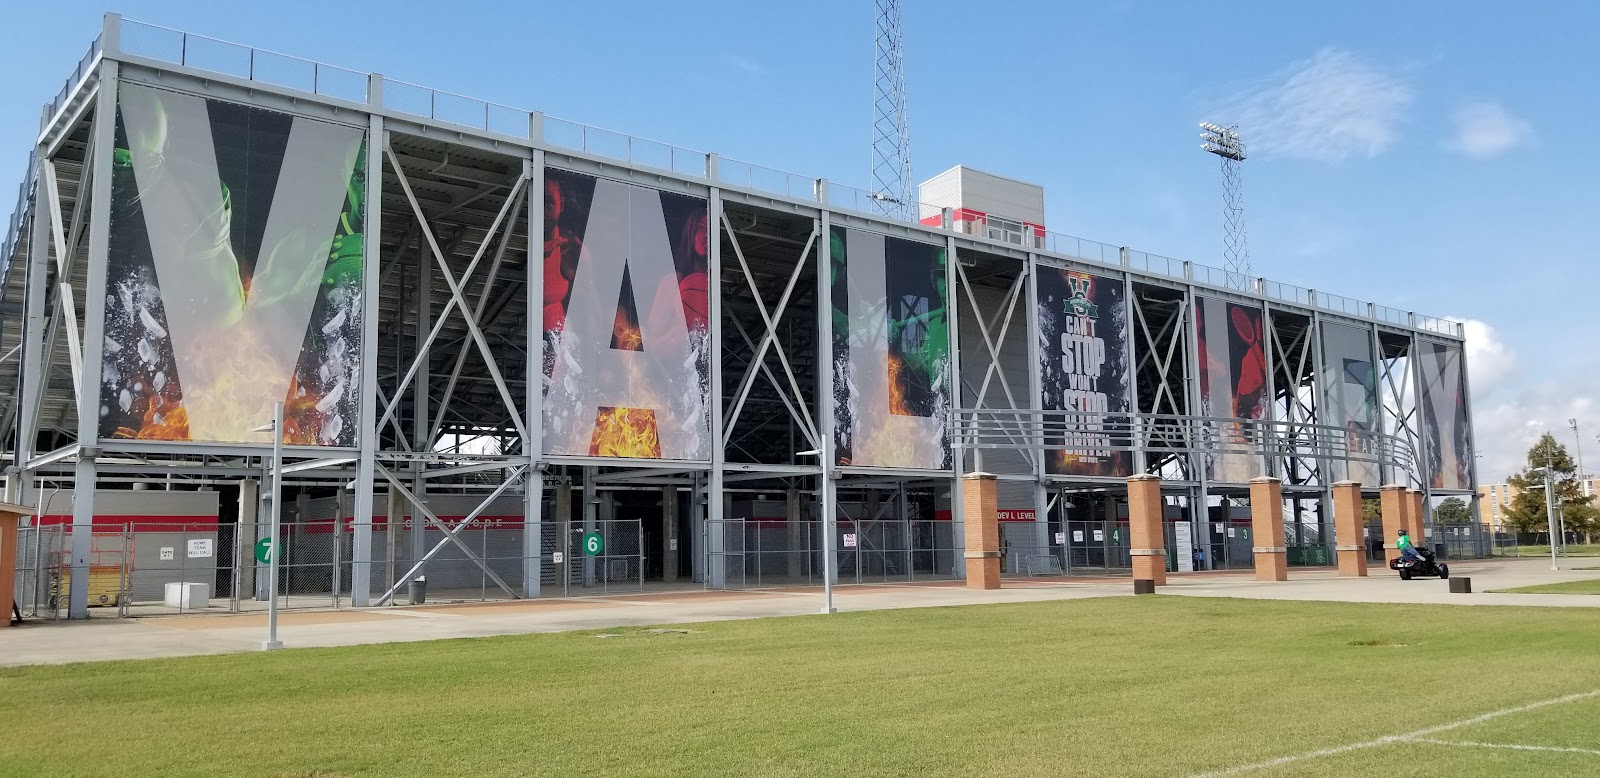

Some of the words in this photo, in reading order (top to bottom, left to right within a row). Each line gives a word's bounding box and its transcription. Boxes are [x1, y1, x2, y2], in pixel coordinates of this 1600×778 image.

[1066, 315, 1096, 337] CAN'T
[1061, 333, 1105, 377] STOP
[1069, 373, 1097, 392] WON'T
[1063, 389, 1108, 431] STOP
[1113, 530, 1119, 541] 4
[1243, 529, 1248, 540] 3
[262, 542, 273, 560] 7
[588, 537, 598, 551] 6
